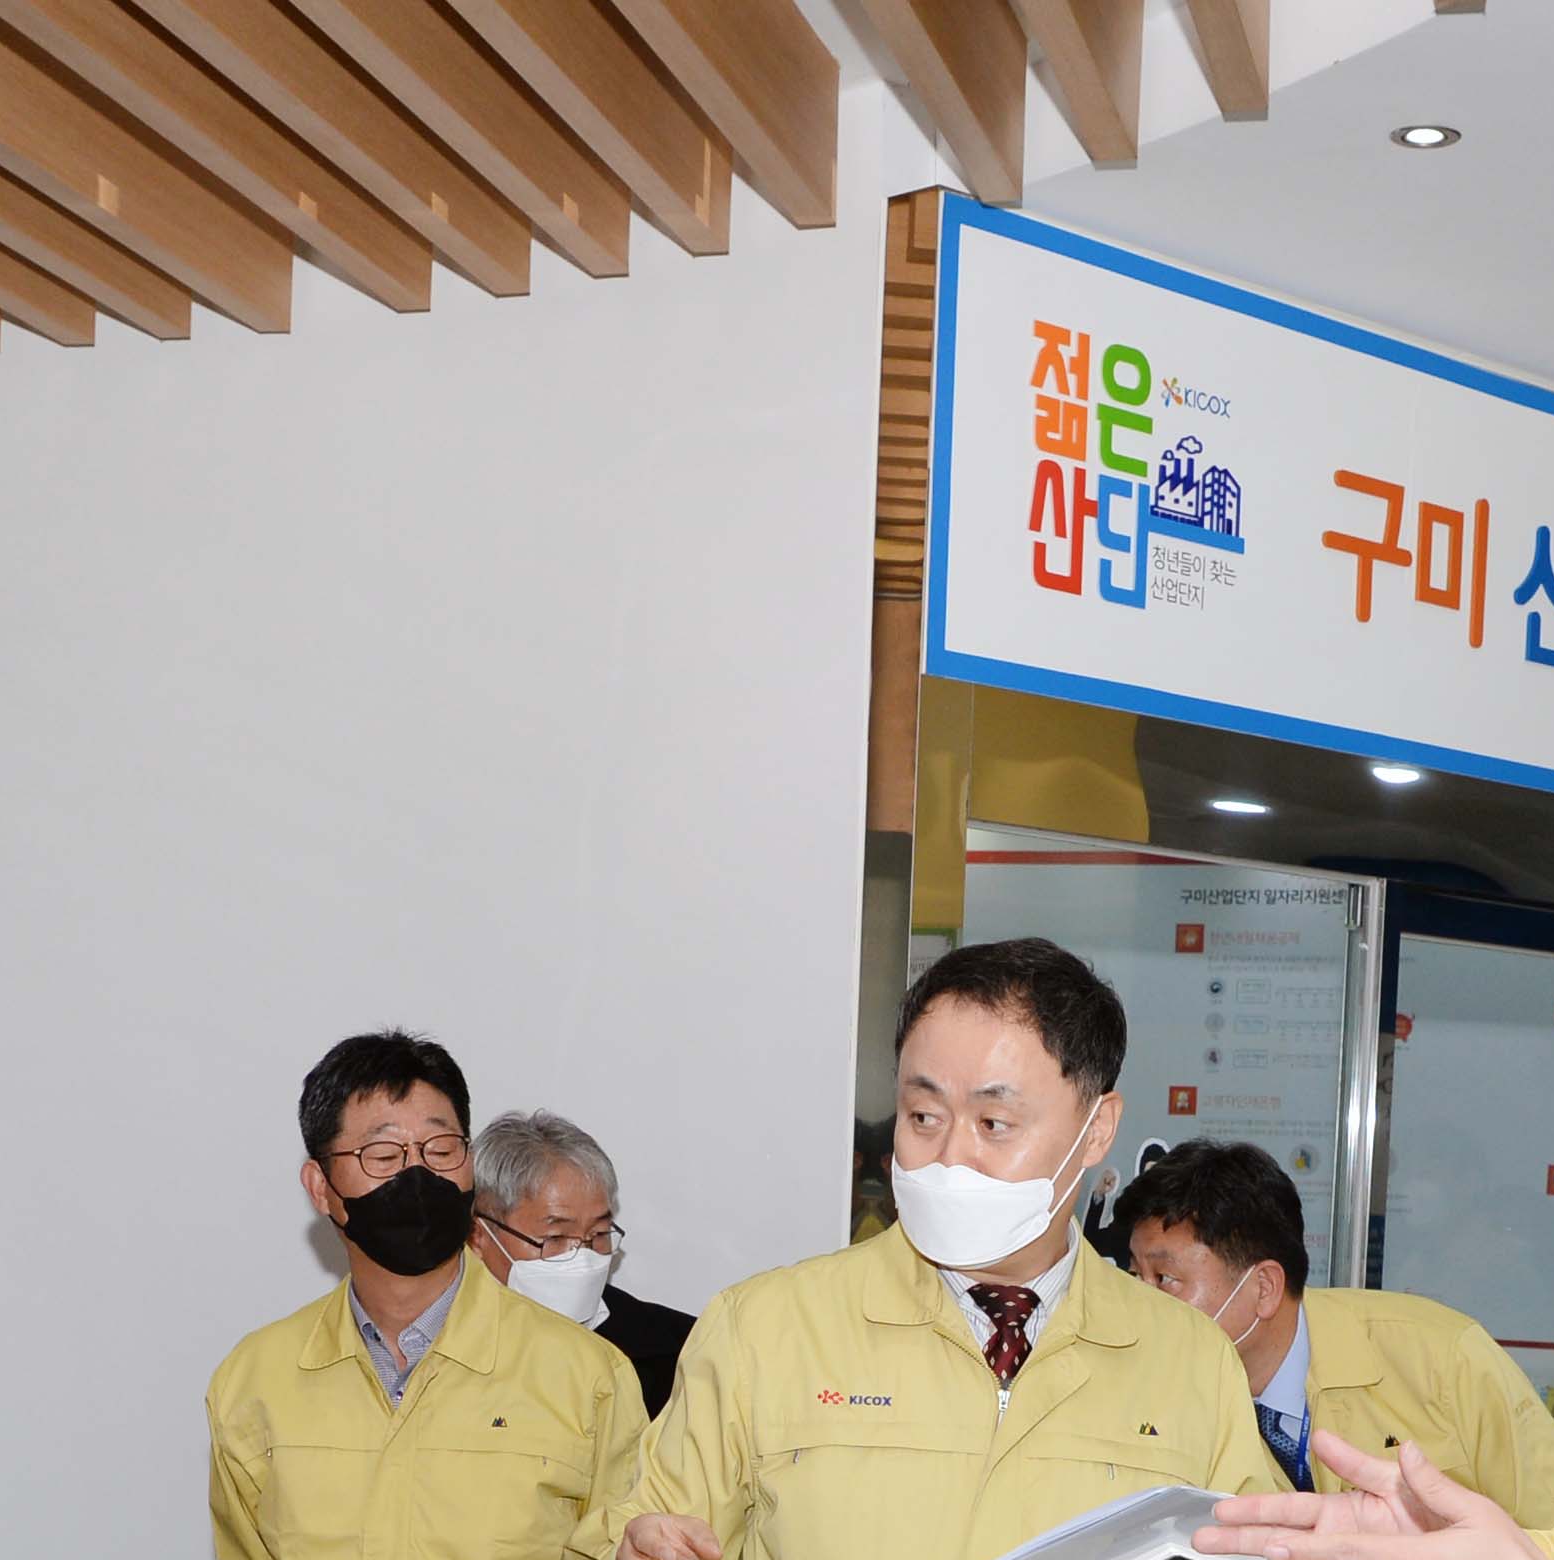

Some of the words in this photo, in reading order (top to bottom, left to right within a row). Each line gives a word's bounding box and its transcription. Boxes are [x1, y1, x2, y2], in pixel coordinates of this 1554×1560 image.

[1031, 319, 1153, 478] 젊은
[1184, 386, 1231, 418] KICOX
[1028, 459, 1150, 610] 산단
[1152, 546, 1207, 581] 청년들이
[1210, 560, 1238, 587] 찾는
[1322, 469, 1489, 650] 구미
[1150, 579, 1205, 610] 산업단지
[1180, 889, 1260, 905] 구미산업단지
[1263, 889, 1347, 906] 일자리지원센
[849, 1395, 892, 1407] KICOX
